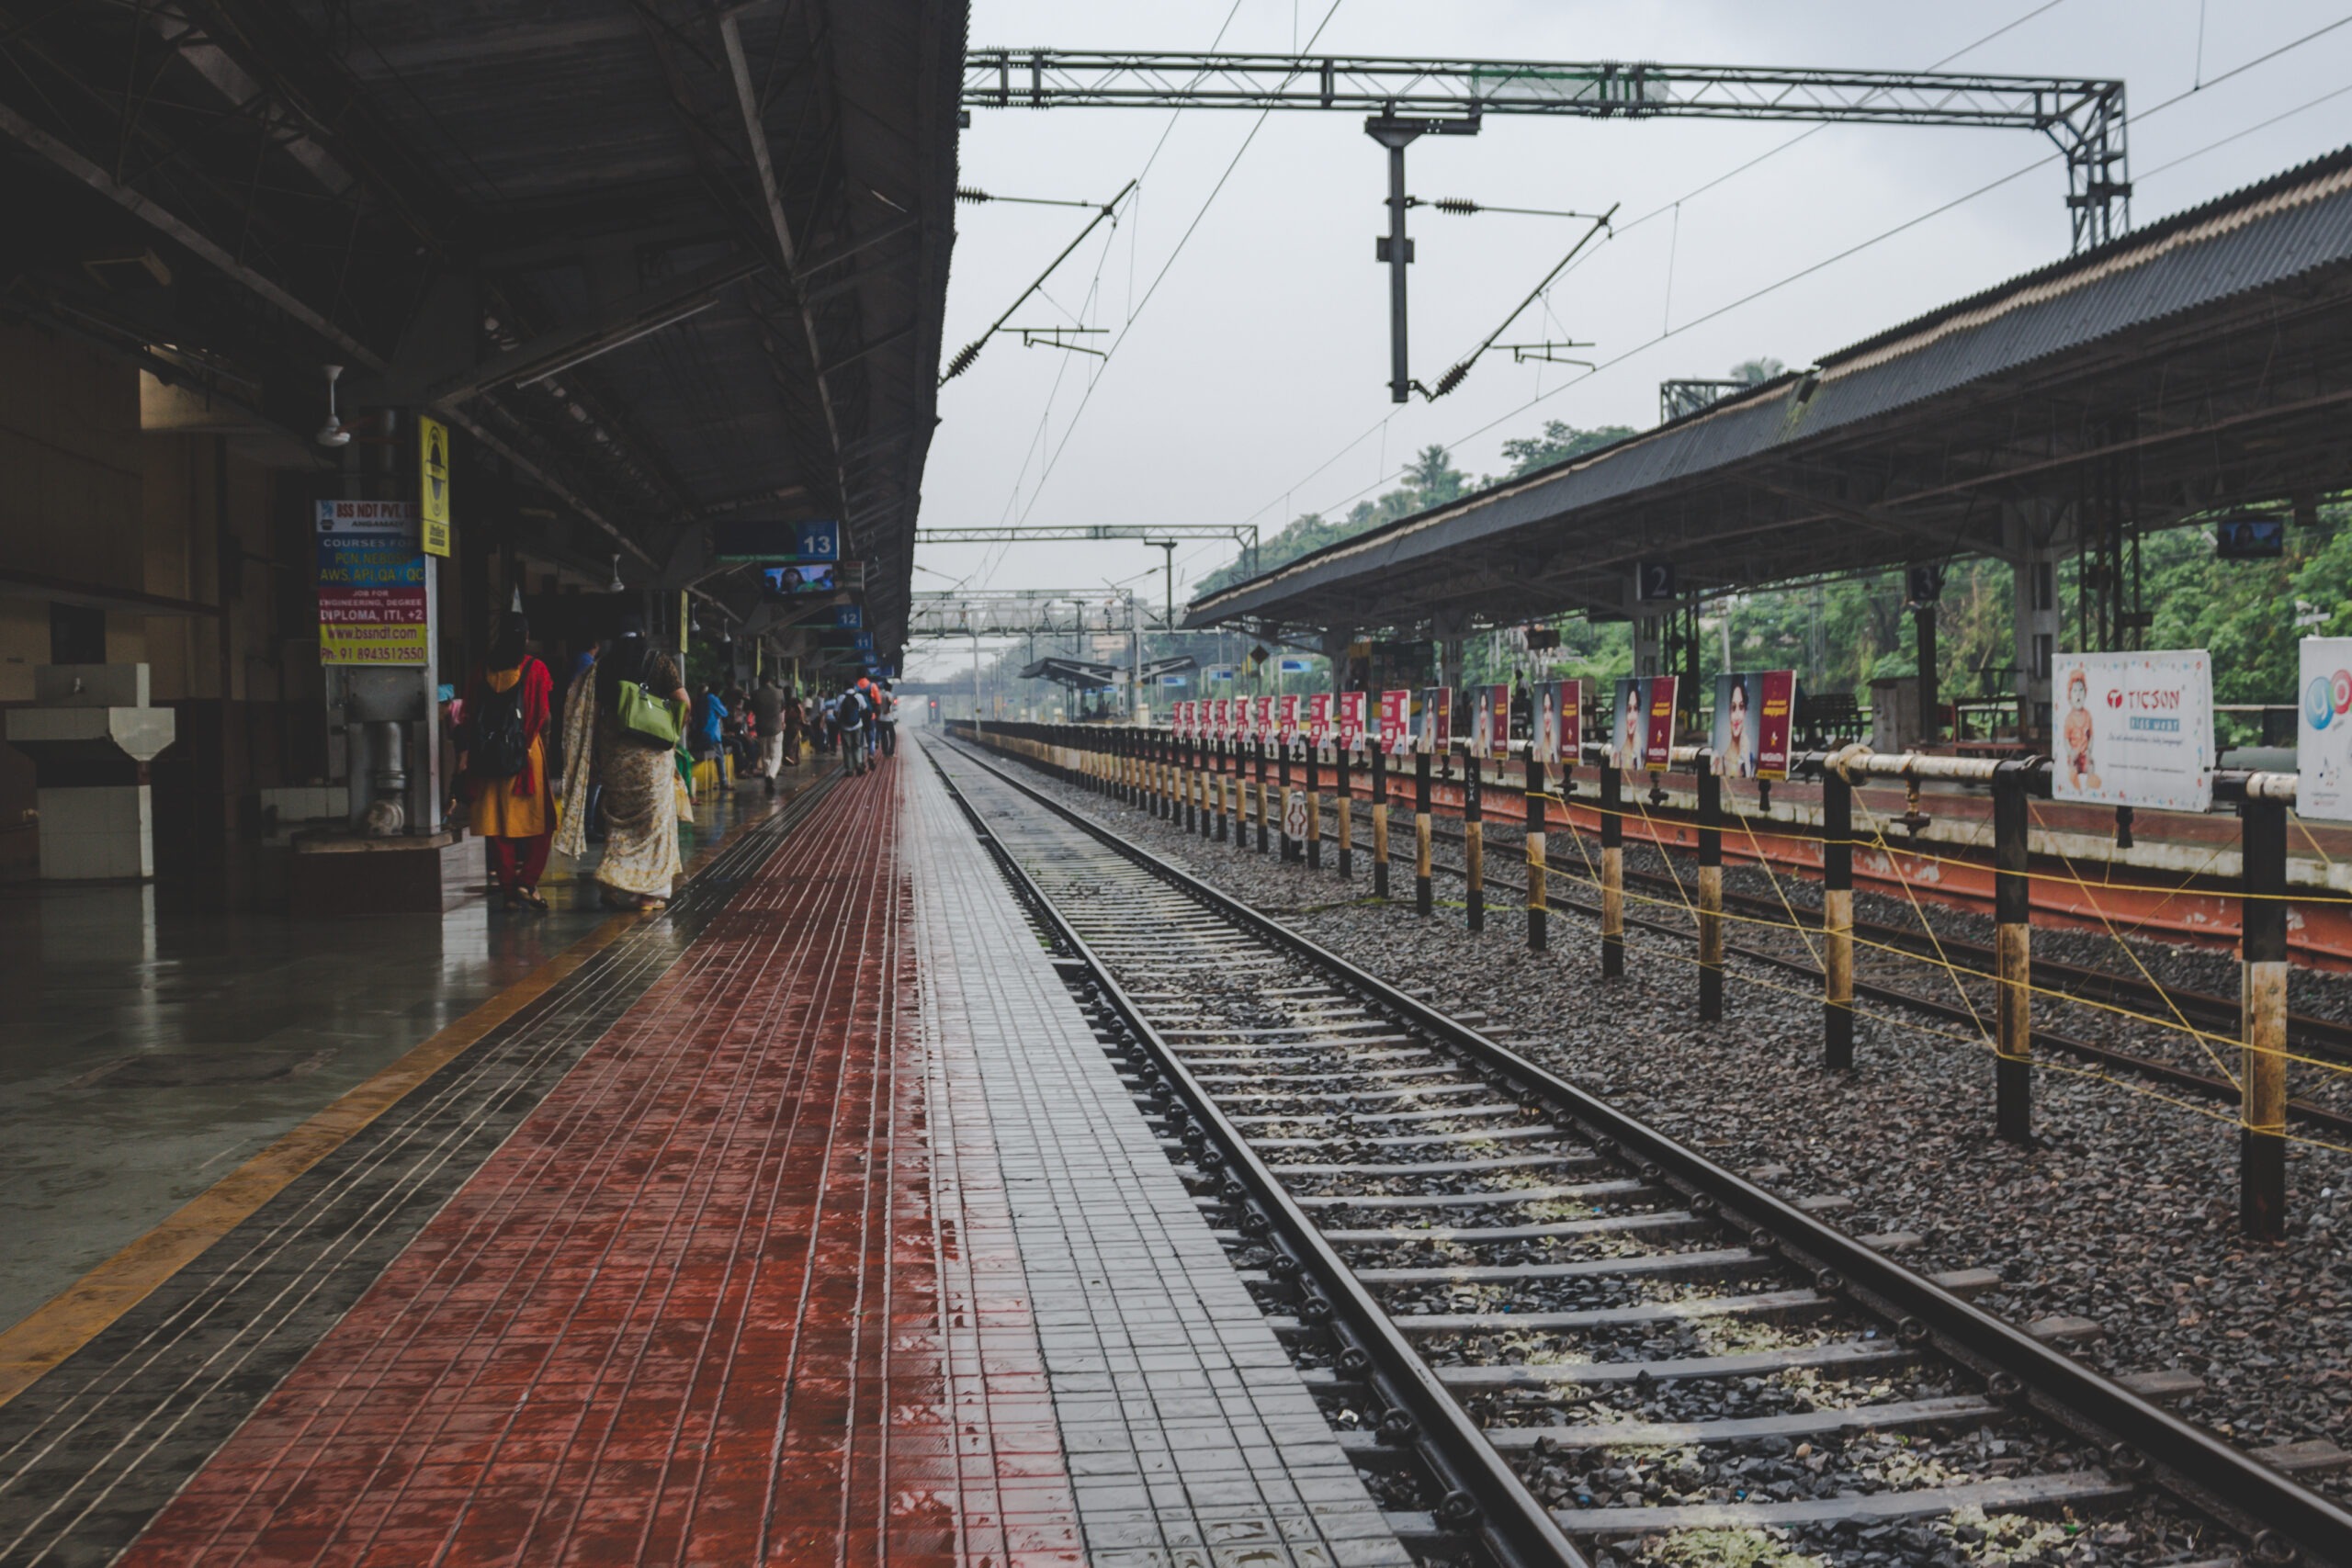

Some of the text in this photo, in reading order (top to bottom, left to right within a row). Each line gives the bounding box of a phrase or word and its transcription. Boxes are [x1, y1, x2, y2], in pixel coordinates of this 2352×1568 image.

[336, 503, 355, 518] BSS
[356, 503, 379, 518] NDT
[322, 538, 386, 547] COURSES
[803, 535, 831, 554] 13
[1651, 565, 1668, 596] 2
[1919, 567, 1933, 598] 3
[386, 598, 423, 606] DEGREE
[320, 609, 380, 623] DIPLOMA,
[407, 609, 424, 621] +2
[840, 612, 858, 625] 12
[856, 638, 868, 648] 11
[340, 647, 352, 660] 91
[356, 647, 424, 660] 8943512550
[2128, 689, 2181, 710] TICSON
